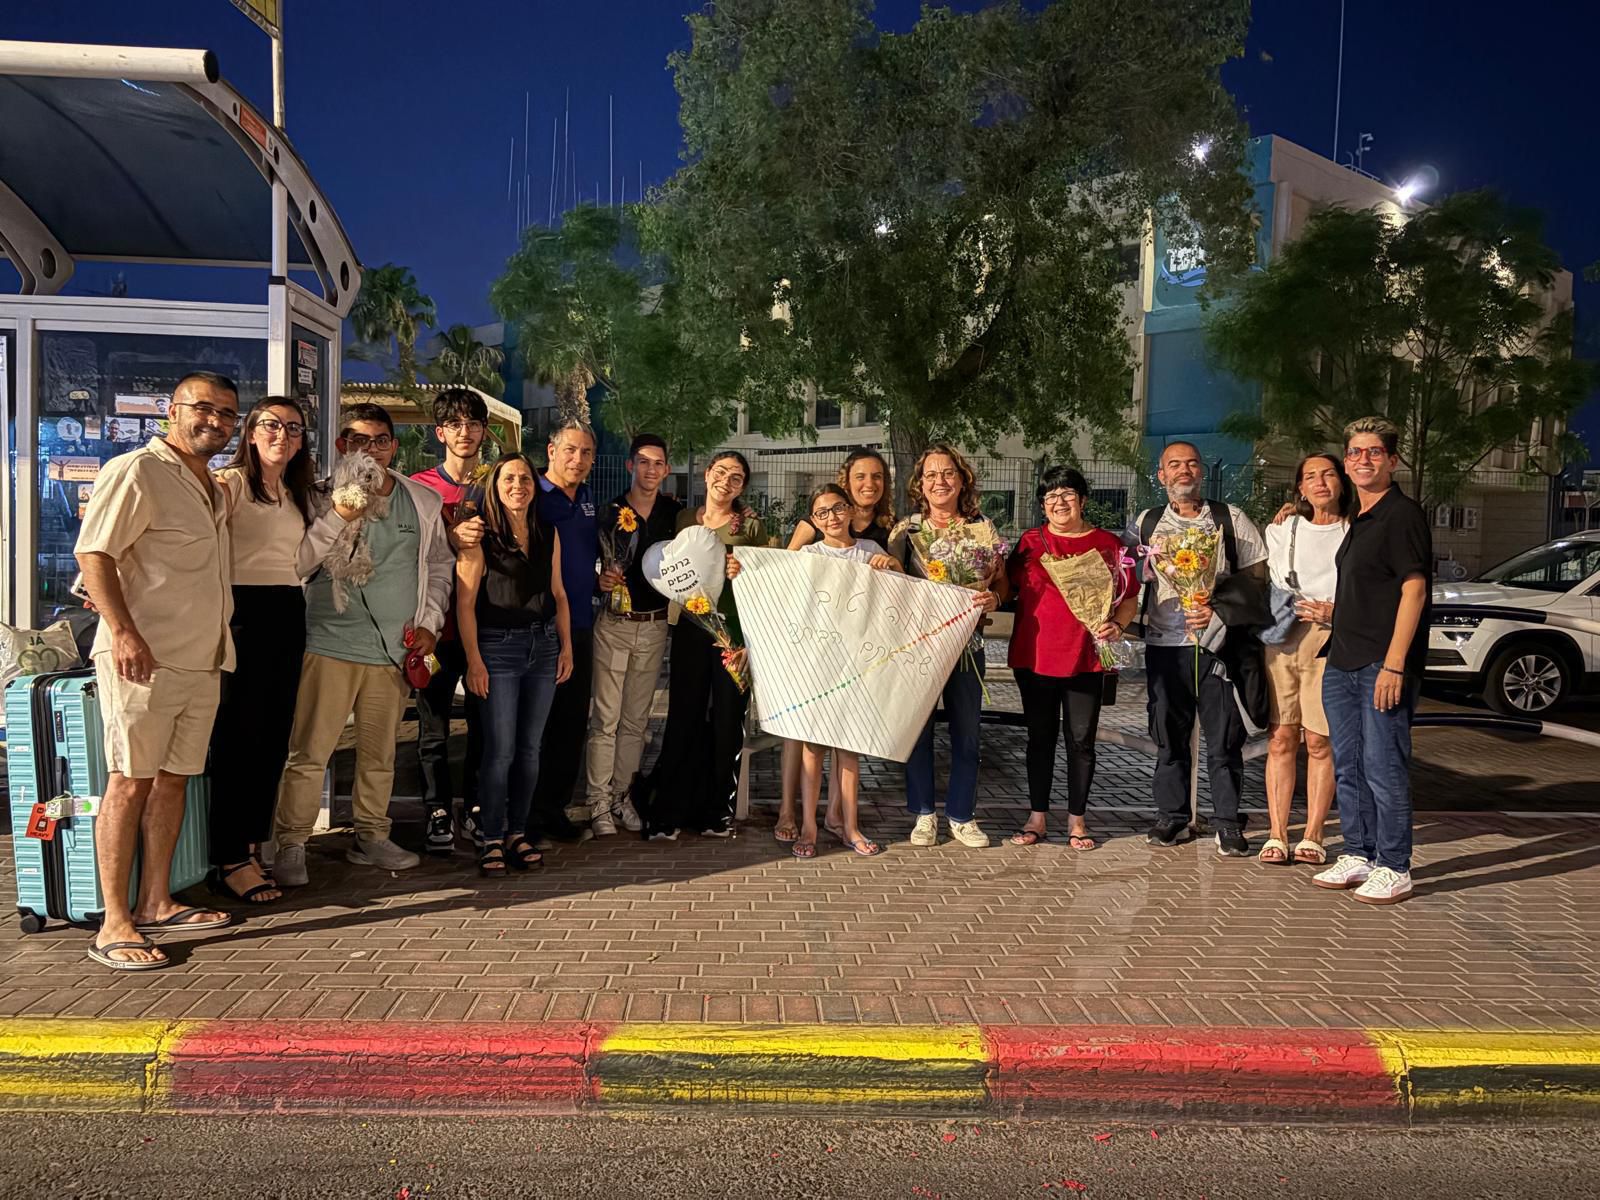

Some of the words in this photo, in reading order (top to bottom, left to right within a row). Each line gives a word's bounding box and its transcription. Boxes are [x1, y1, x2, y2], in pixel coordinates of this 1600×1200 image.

[660, 557, 691, 577] ברוכים
[815, 590, 865, 612] טוב
[885, 606, 944, 636] כמה
